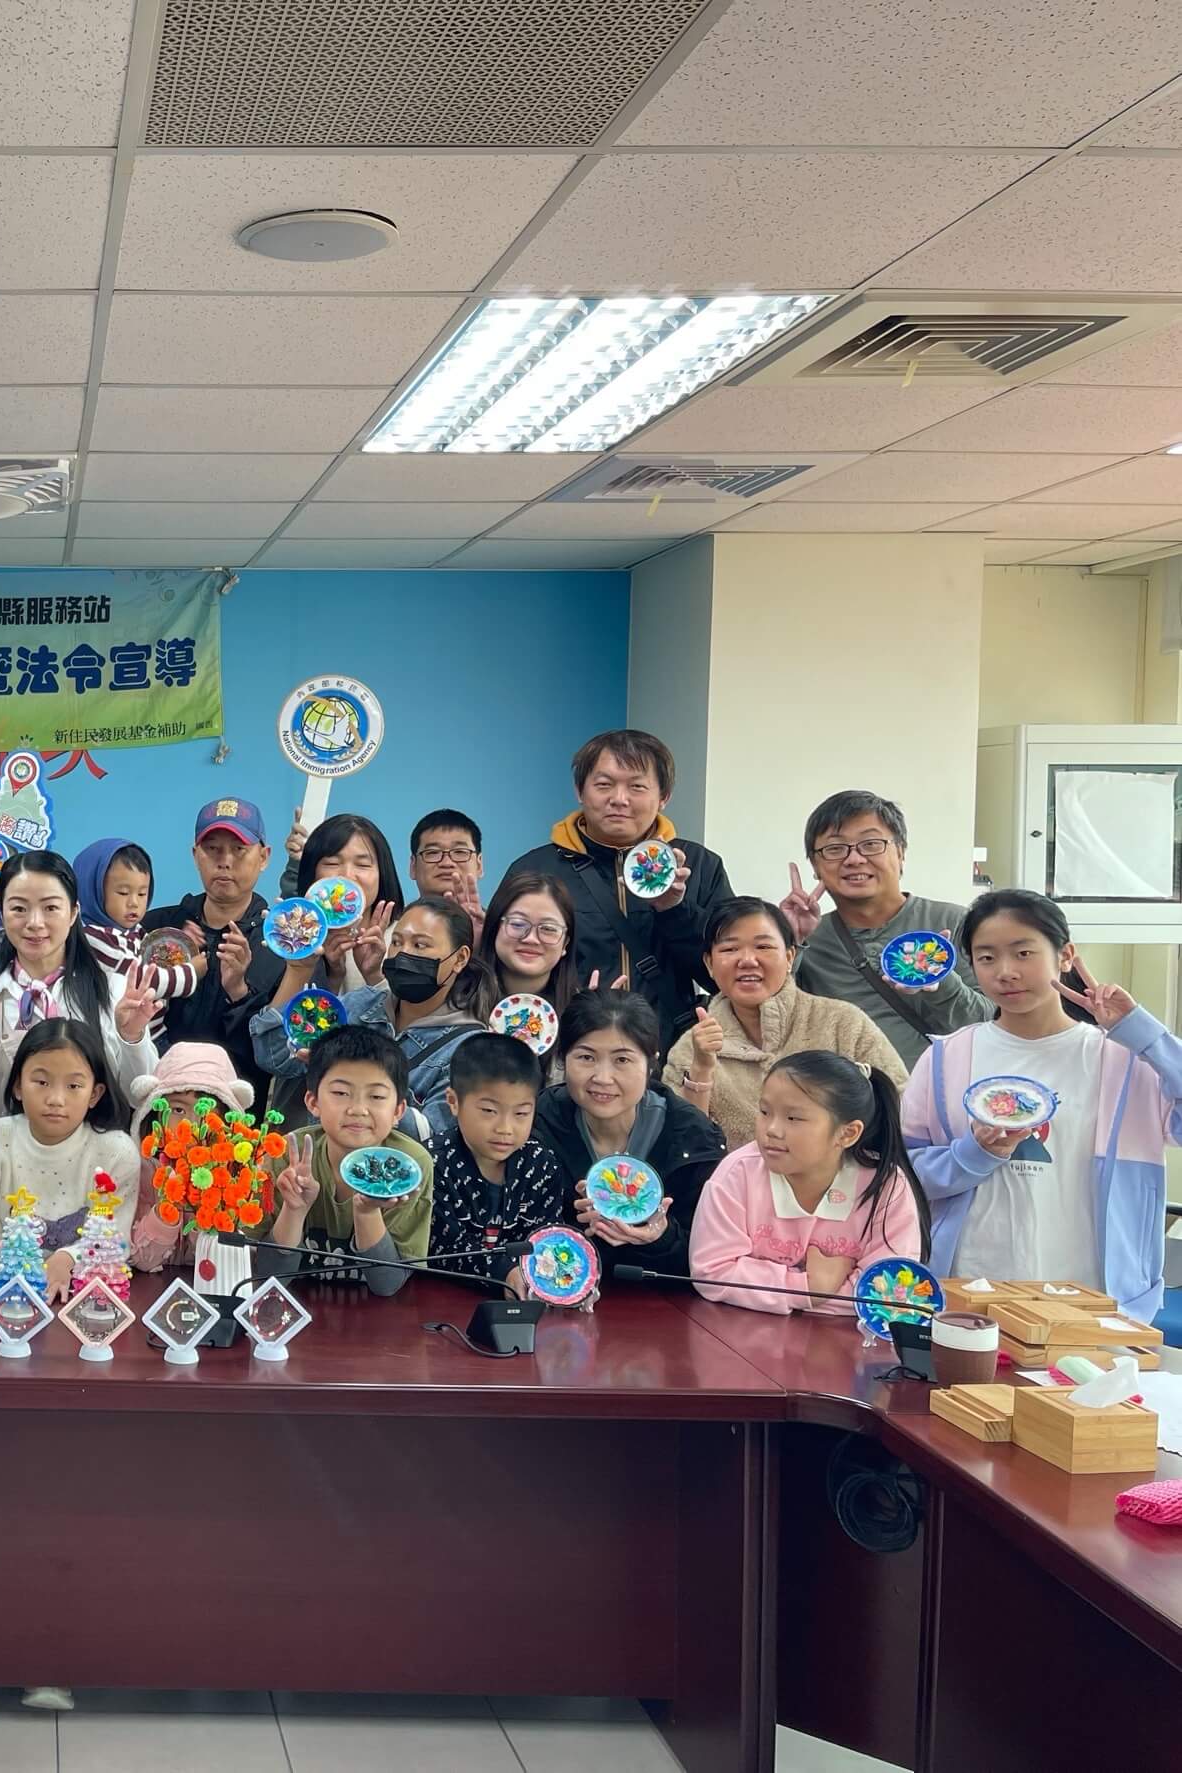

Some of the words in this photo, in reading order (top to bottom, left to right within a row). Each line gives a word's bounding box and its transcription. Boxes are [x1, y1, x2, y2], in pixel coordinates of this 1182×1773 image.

[54, 721, 186, 745] 新住民發展基金補助
[282, 730, 301, 762] National
[300, 758, 351, 775] Immigration
[352, 739, 377, 767] Agency
